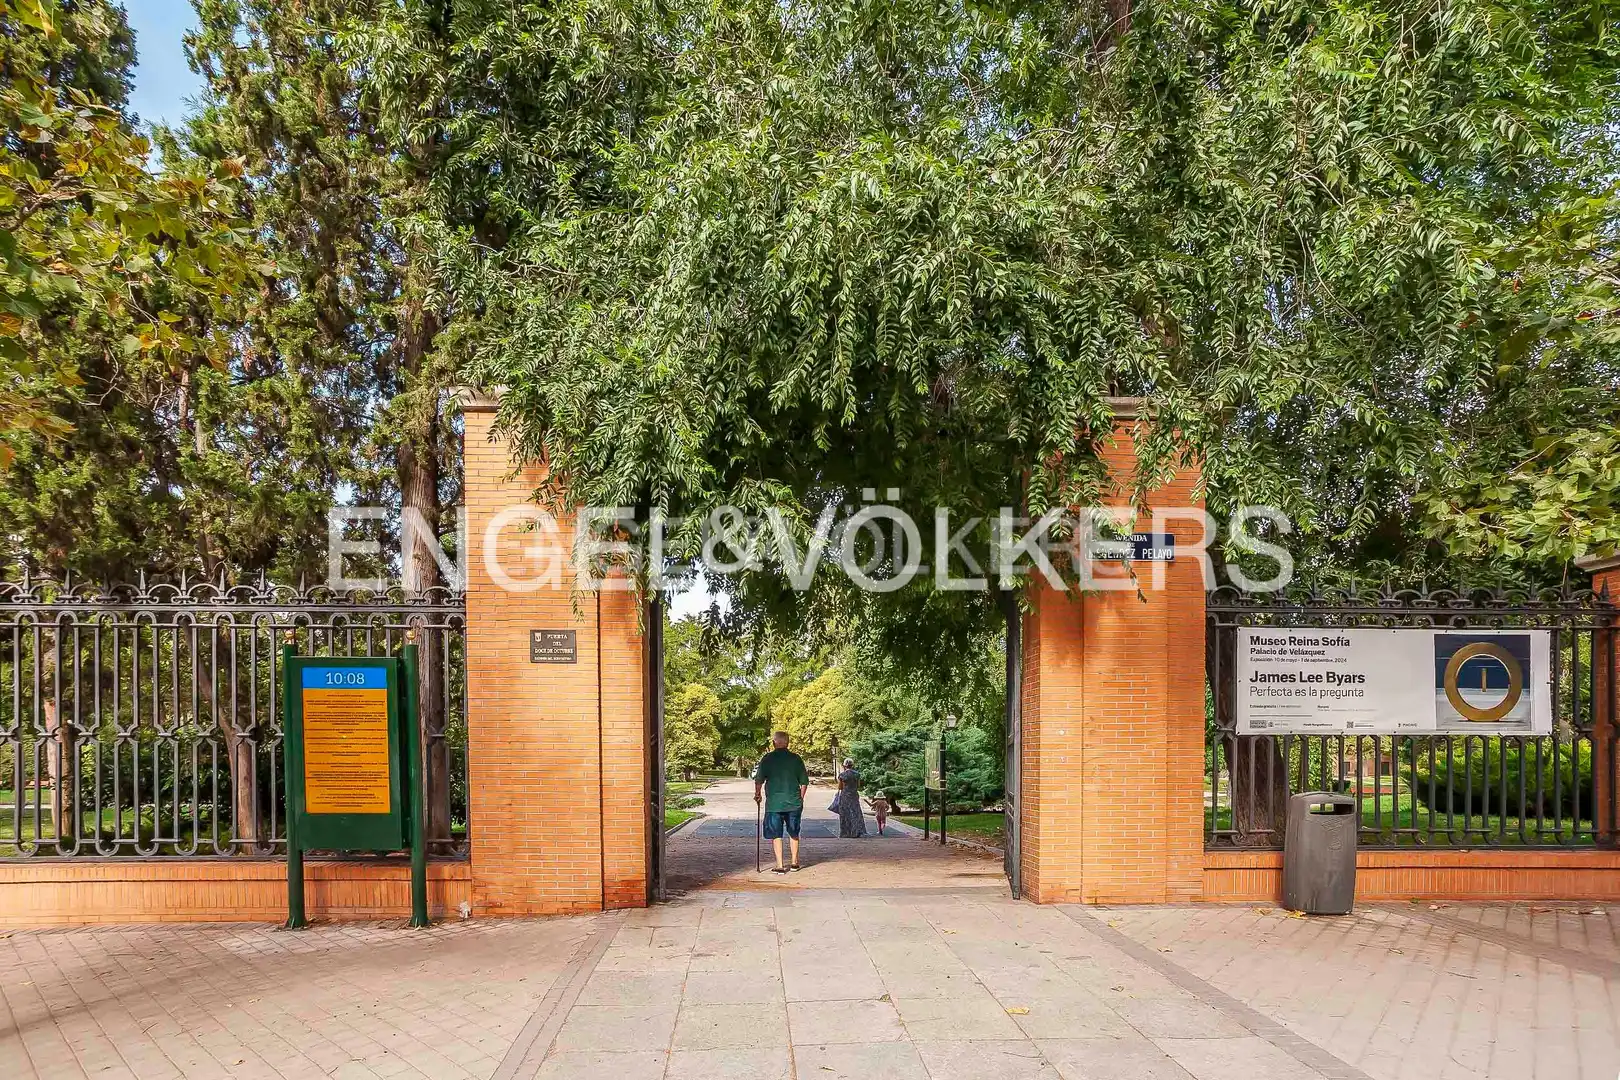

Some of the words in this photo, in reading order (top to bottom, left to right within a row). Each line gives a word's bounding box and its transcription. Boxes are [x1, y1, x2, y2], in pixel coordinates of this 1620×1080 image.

[1142, 548, 1172, 560] PELAYO
[1250, 636, 1287, 646] Museo
[1289, 636, 1320, 647] Reina
[1321, 636, 1350, 647] Sofía
[1278, 648, 1288, 656] de
[1289, 648, 1326, 657] Velázquez
[326, 672, 365, 685] 10:08
[1249, 670, 1296, 683] James
[1299, 671, 1323, 683] Lee
[1326, 671, 1366, 687] Byars
[1249, 686, 1293, 697] Perfecta
[1295, 688, 1307, 697] es
[1308, 686, 1317, 697] la
[1319, 688, 1364, 700] pregunta
